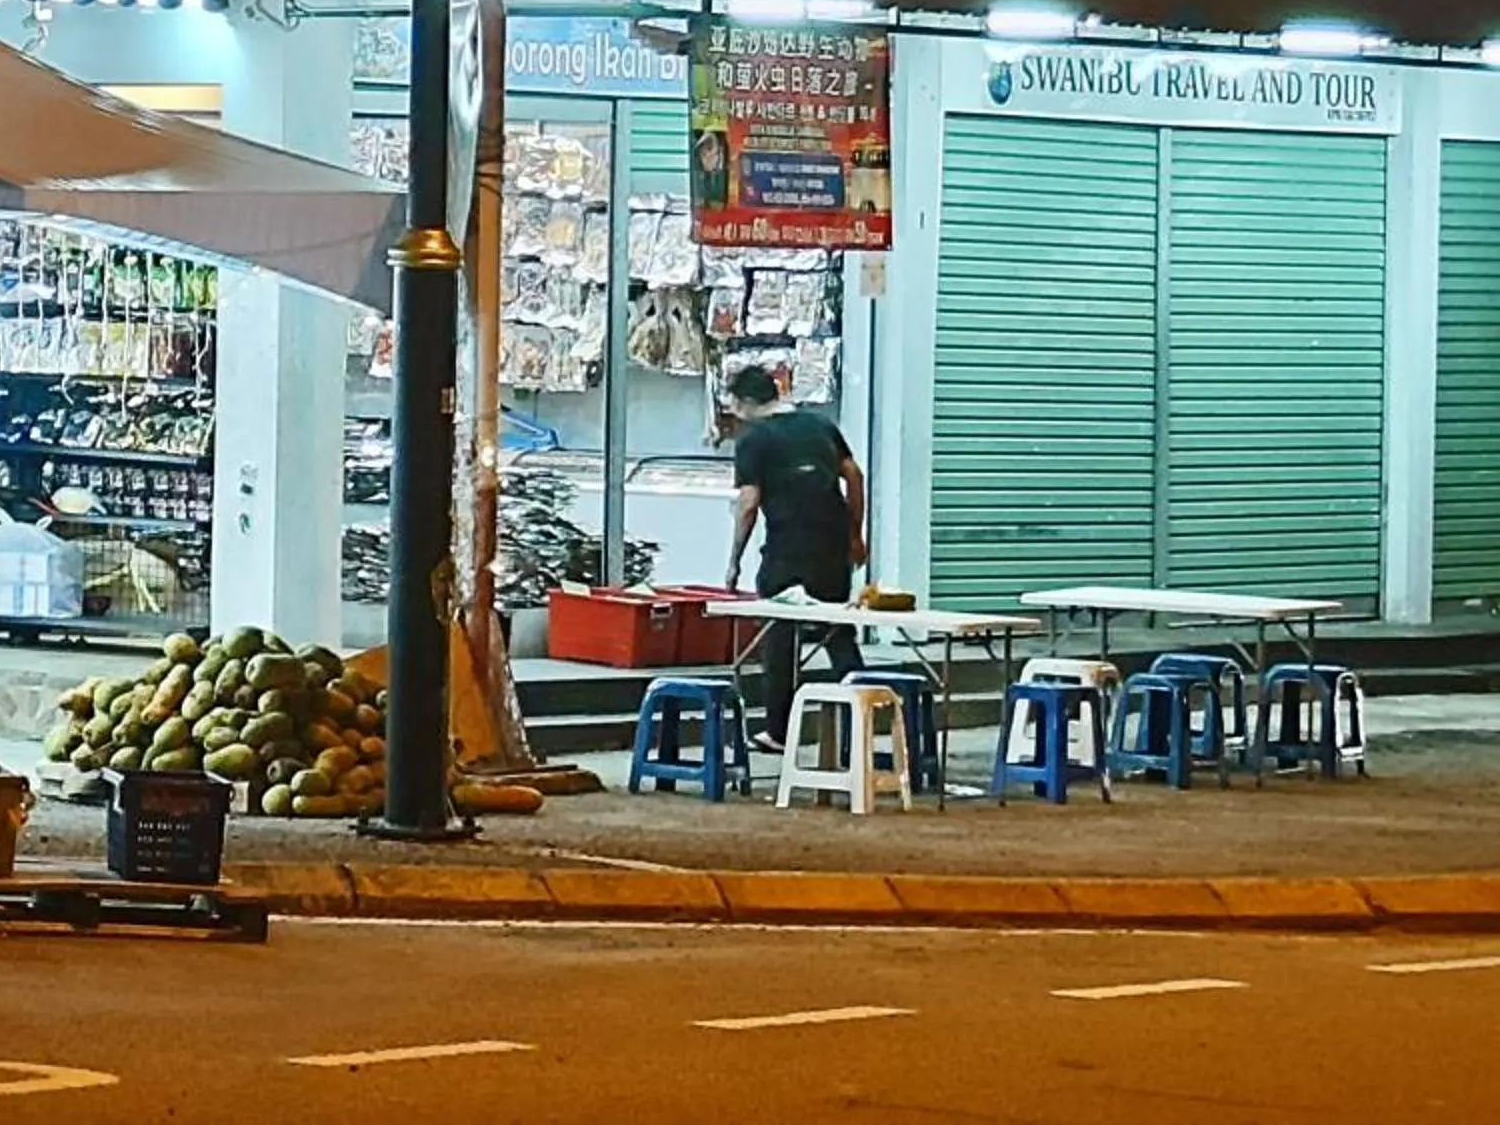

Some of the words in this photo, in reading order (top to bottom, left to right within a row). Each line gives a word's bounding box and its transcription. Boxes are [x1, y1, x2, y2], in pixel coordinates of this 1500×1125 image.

[505, 41, 586, 85] orong
[594, 32, 652, 79] Ikan
[1252, 69, 1303, 105] AND
[1309, 72, 1377, 109] TOUR
